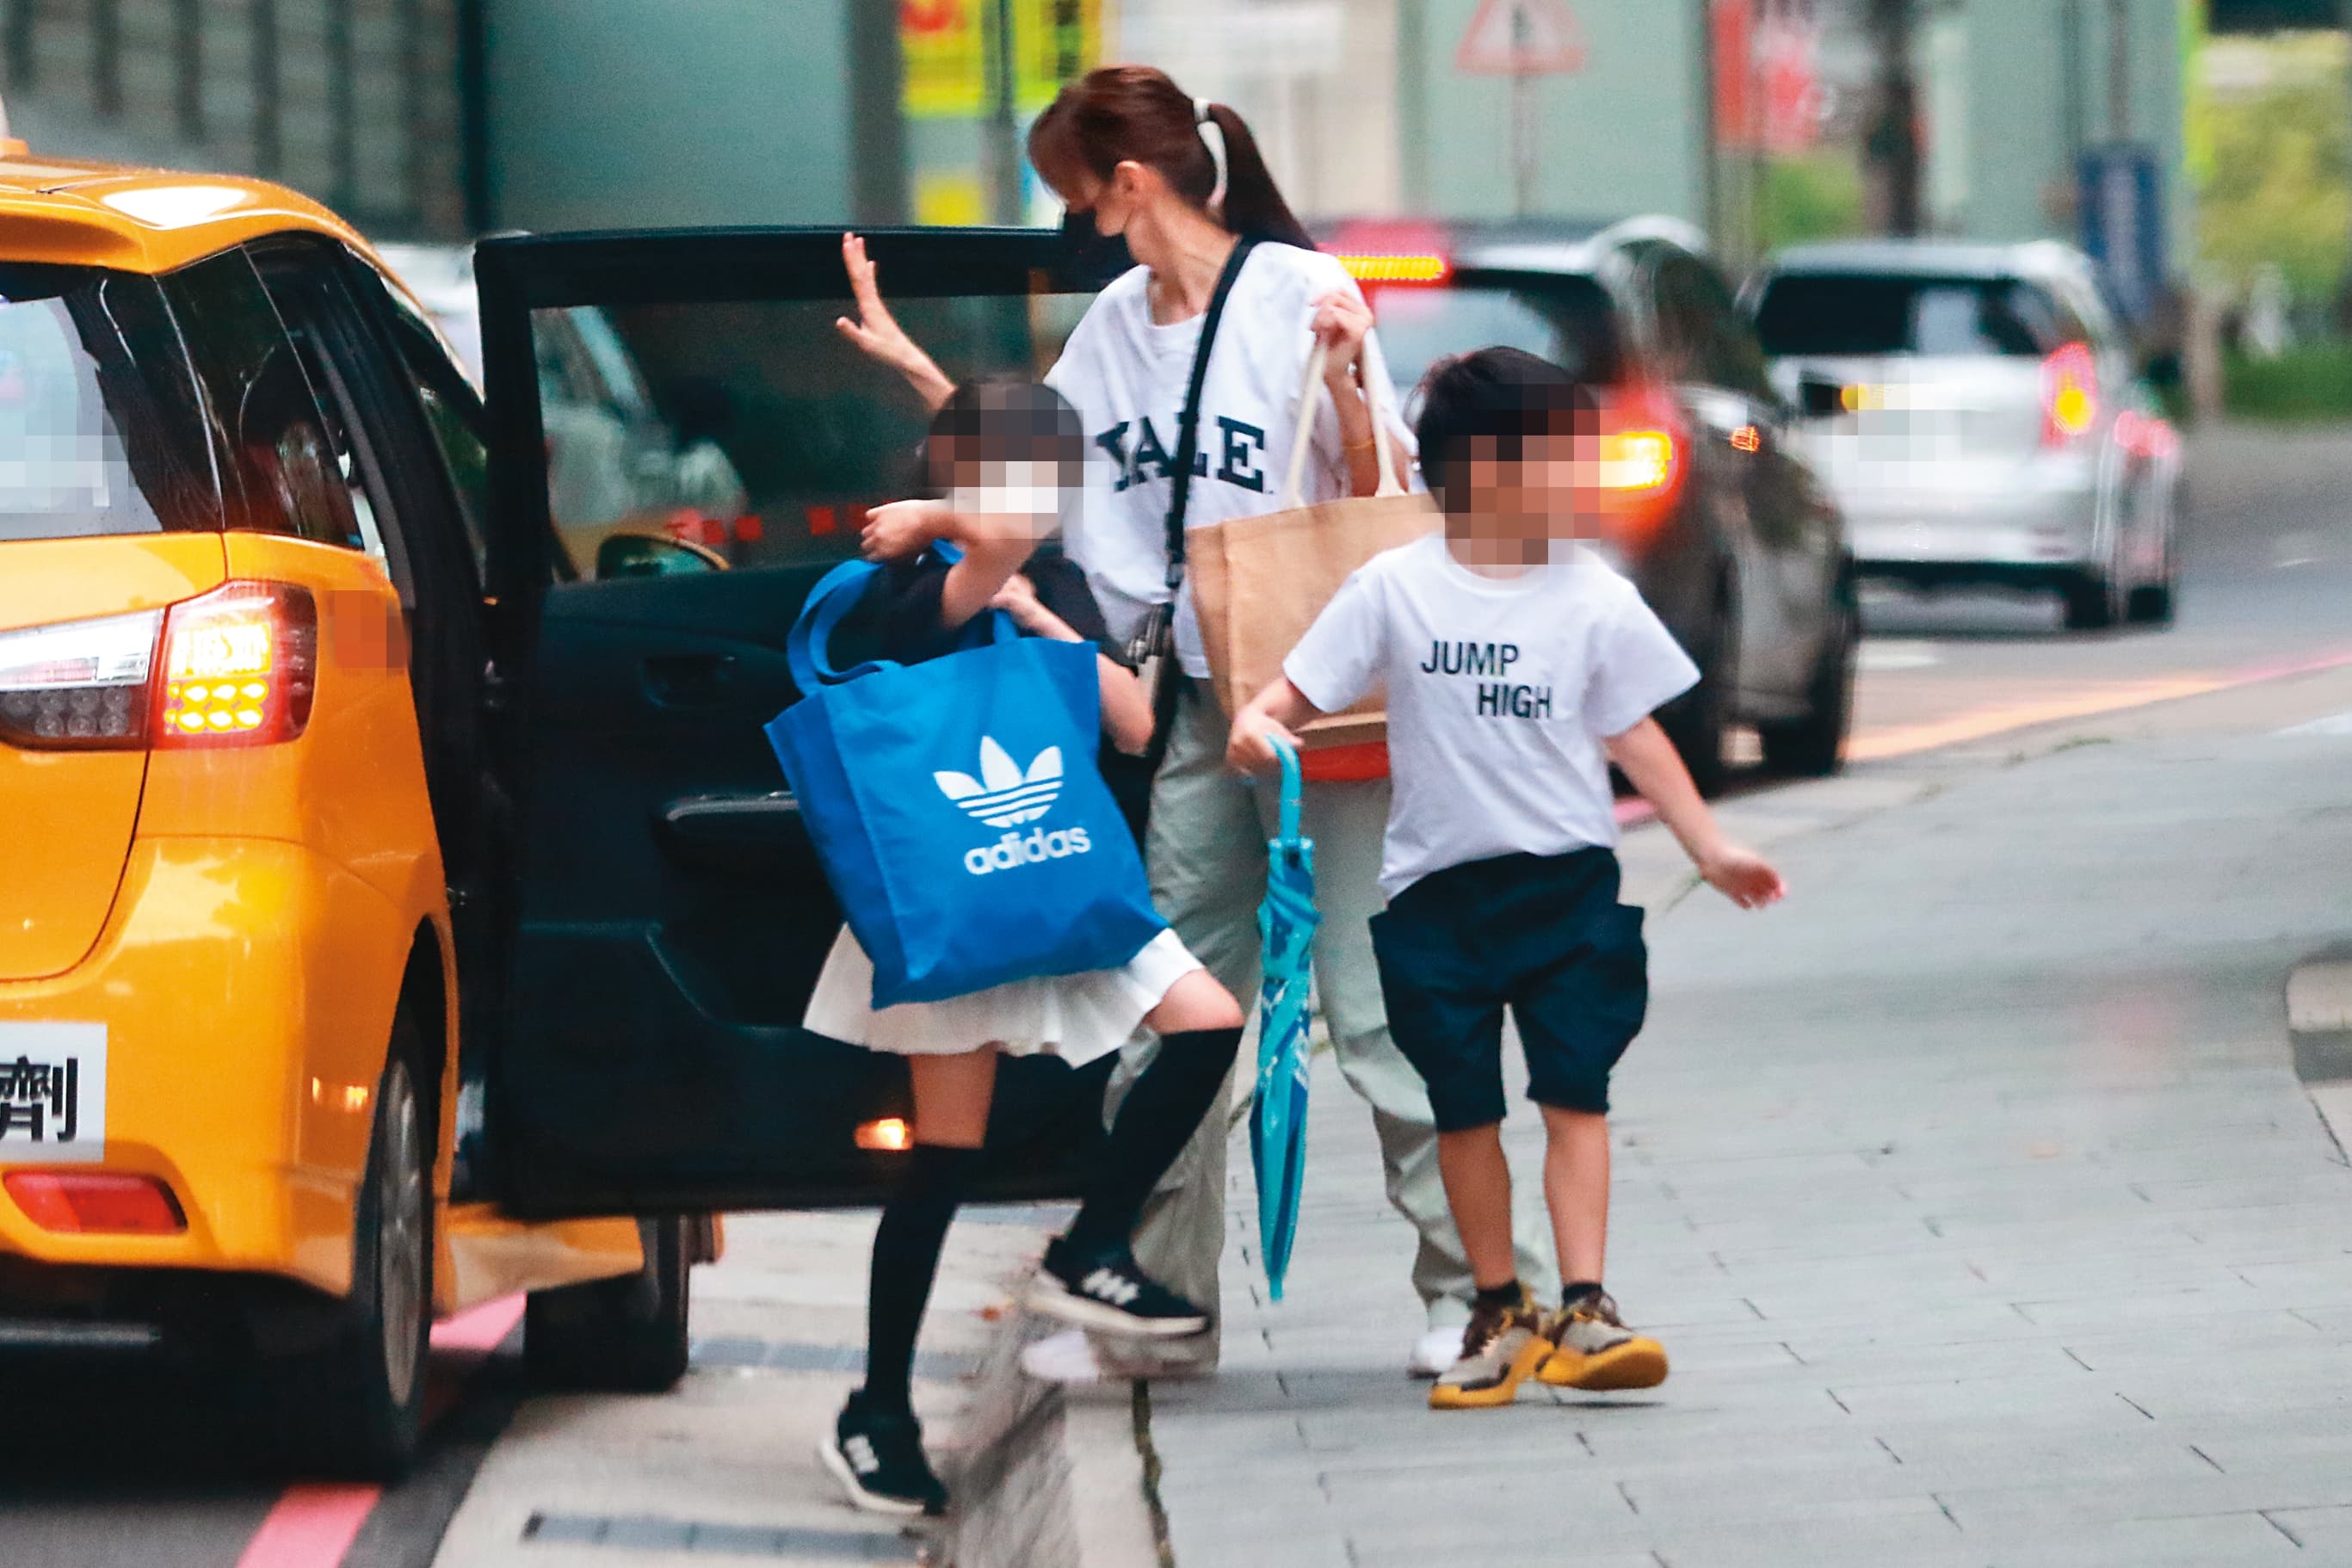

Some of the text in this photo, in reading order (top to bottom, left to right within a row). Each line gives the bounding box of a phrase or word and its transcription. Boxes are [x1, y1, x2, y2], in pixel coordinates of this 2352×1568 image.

[1422, 640, 1519, 676] JUMP
[1478, 683, 1553, 718] HIGH
[964, 827, 1091, 874] adidas
